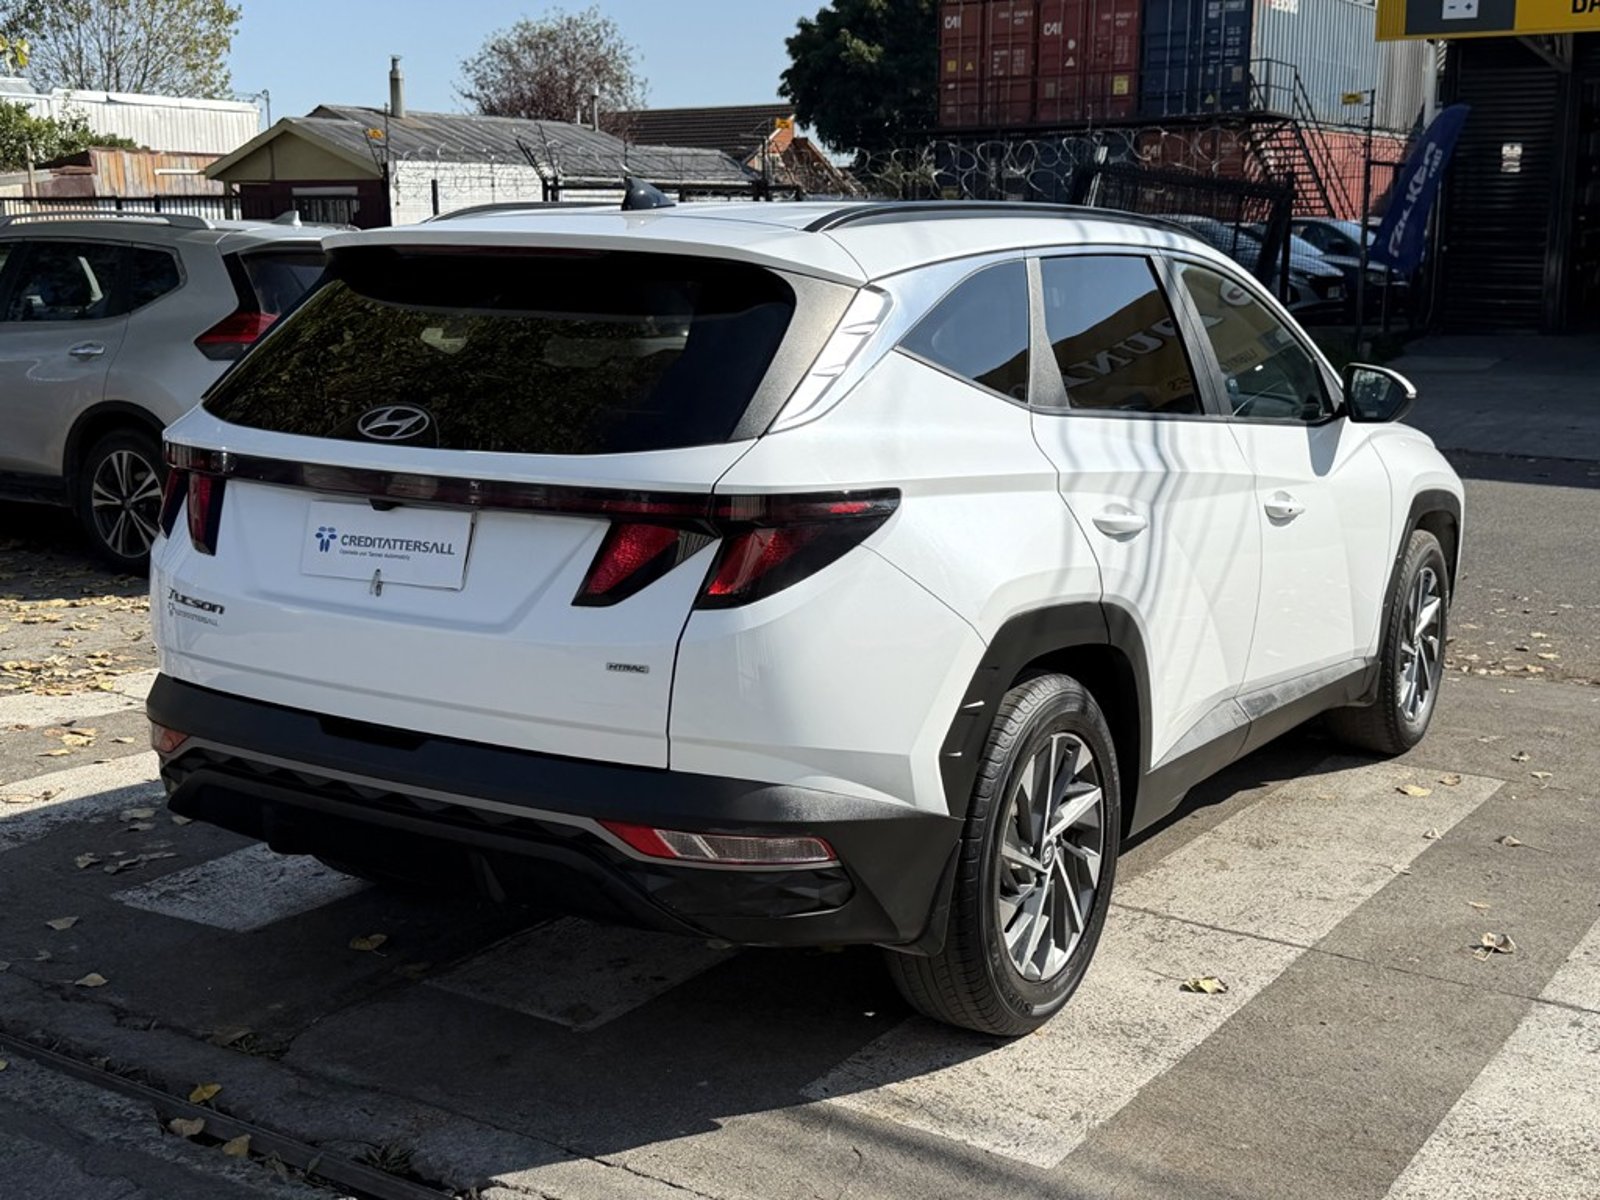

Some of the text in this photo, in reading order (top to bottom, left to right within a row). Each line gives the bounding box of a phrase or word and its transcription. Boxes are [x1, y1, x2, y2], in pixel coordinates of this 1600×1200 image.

[1043, 22, 1062, 36] CAI
[340, 534, 456, 556] CREDITATTERSALL
[167, 586, 225, 615] Tucson
